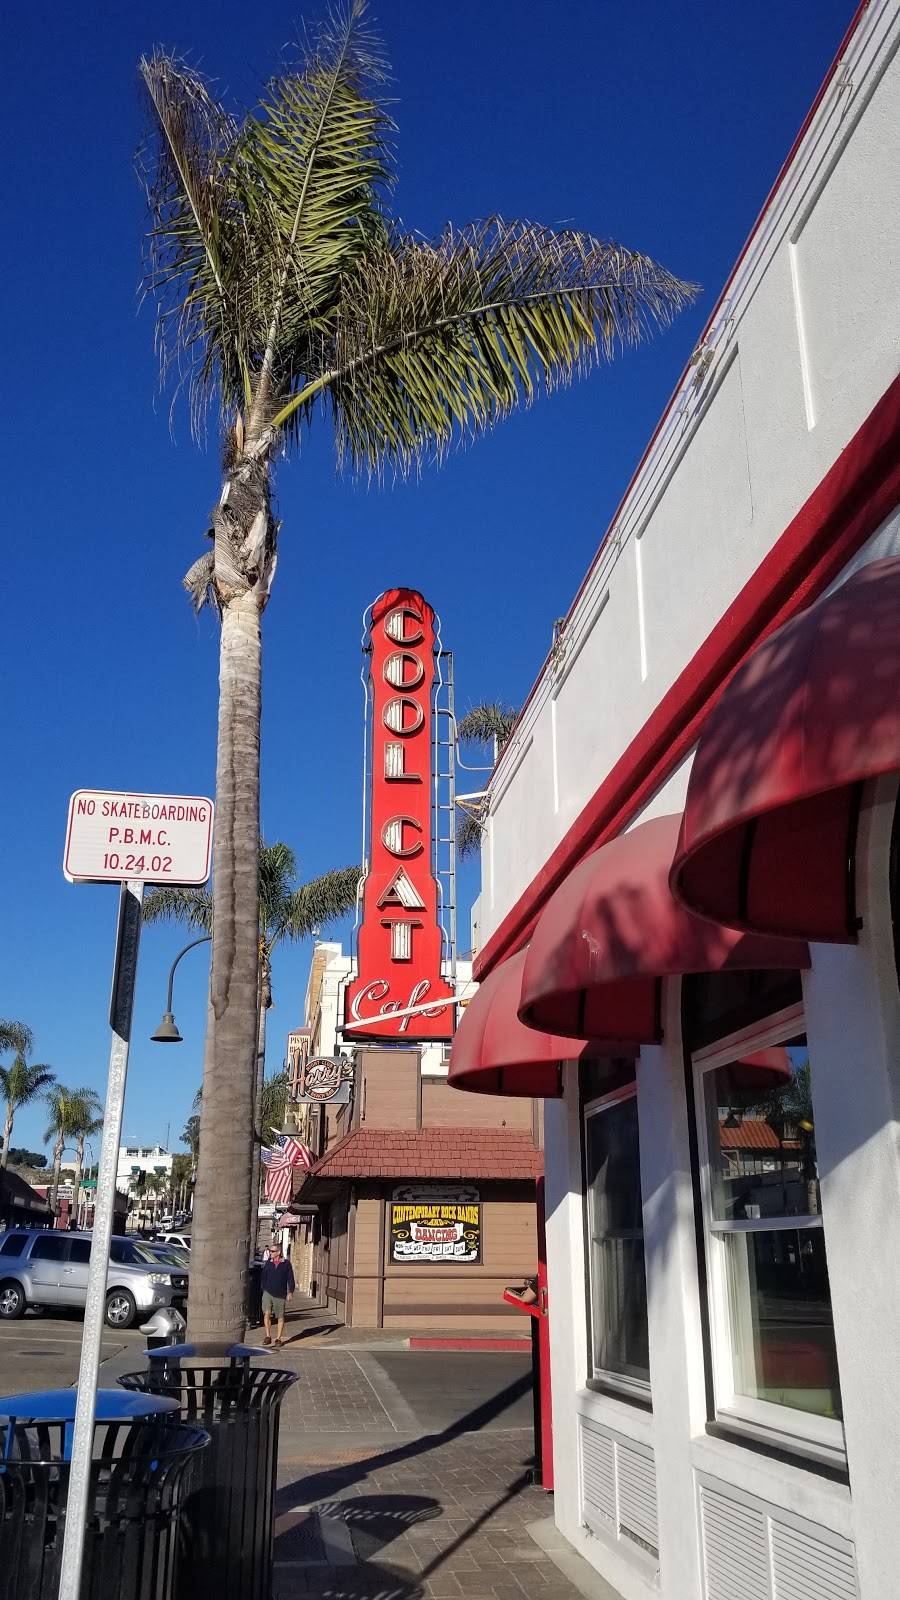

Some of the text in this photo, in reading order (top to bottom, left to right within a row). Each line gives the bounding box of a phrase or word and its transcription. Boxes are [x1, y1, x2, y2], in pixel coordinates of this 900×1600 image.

[376, 606, 426, 961] COOL CAT
[77, 799, 207, 823] NO SKATEBOARDING
[108, 827, 171, 846] P.B.M.C.
[104, 853, 173, 873] 10.24.02
[286, 1041, 353, 1099] Harry's
[392, 1205, 479, 1225] CONTEMPORARY ROCK BANDS
[415, 1228, 458, 1242] DANCING
